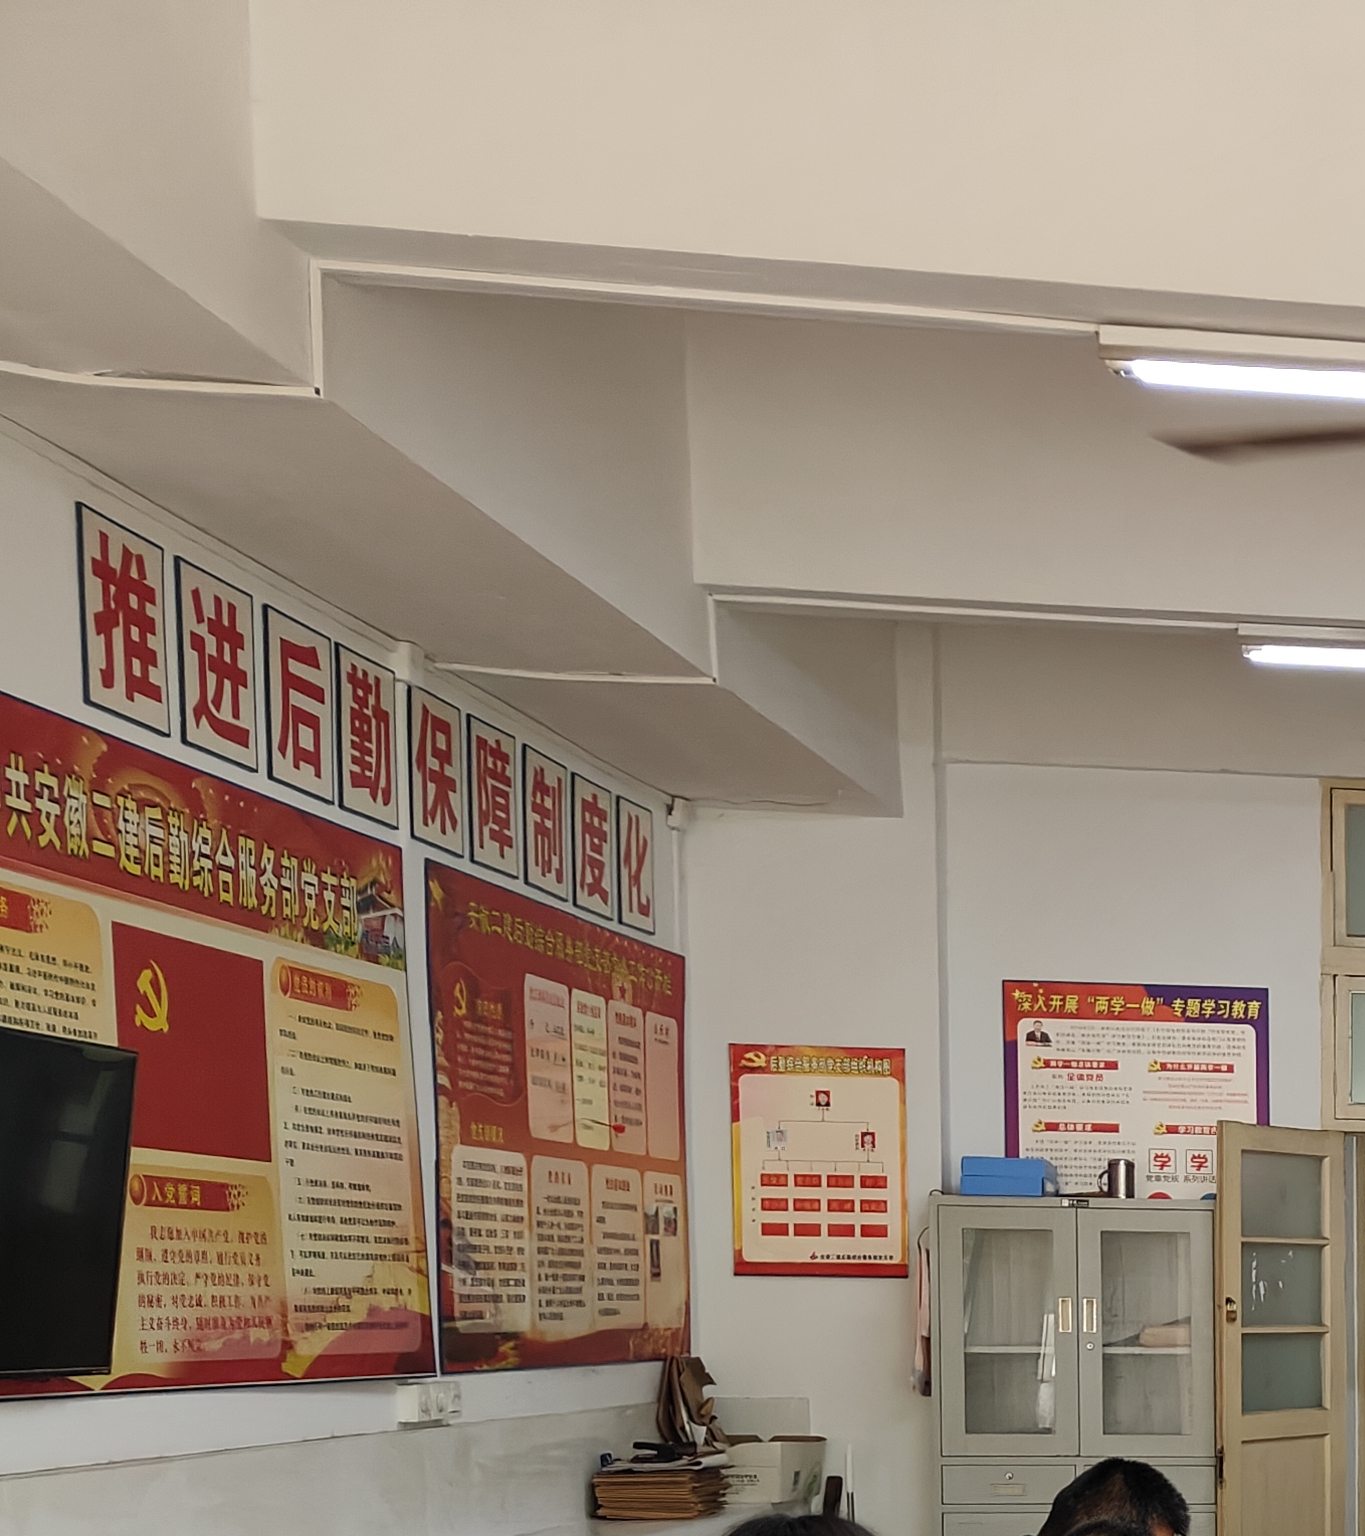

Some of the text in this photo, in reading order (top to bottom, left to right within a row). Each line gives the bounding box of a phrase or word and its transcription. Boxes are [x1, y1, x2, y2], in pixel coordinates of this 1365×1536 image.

[92, 530, 652, 918] 推进后勤保障制度化
[4, 752, 358, 939] 共安徽二建后勤综合服务部党支部
[1017, 994, 1261, 1020] 深入开展“两学一做”专题学习教育
